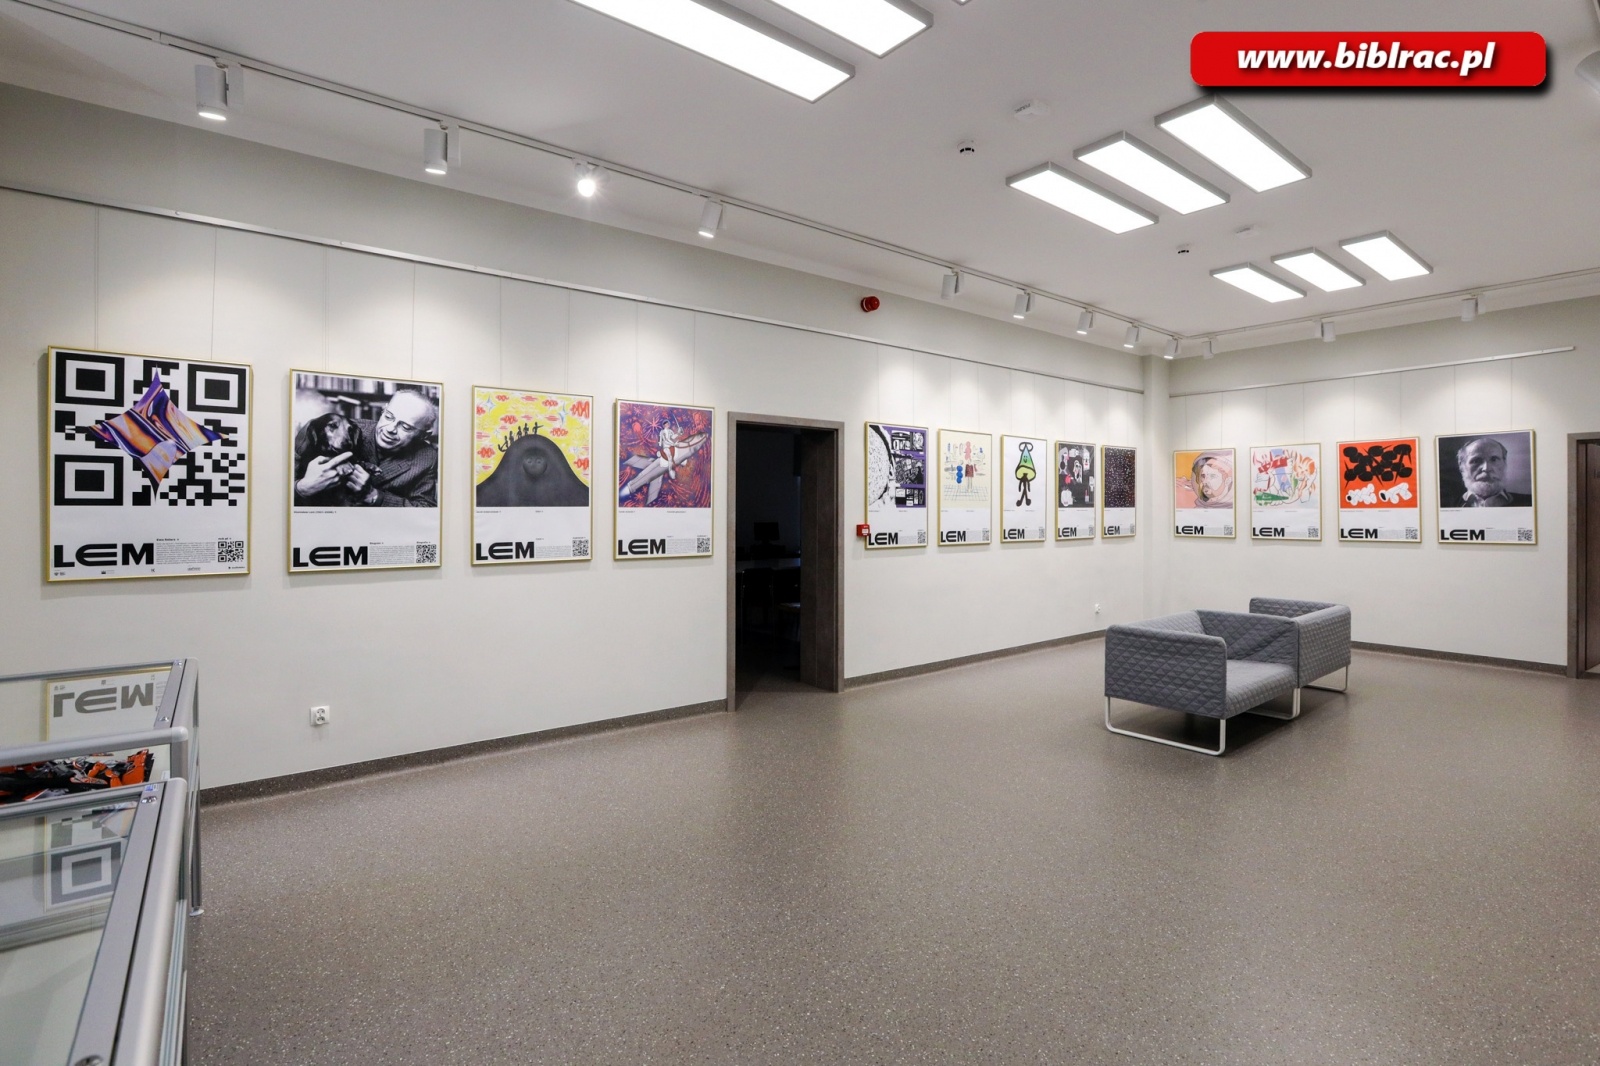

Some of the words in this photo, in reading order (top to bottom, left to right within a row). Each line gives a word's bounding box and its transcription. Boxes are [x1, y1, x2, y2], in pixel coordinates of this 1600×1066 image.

[1003, 528, 1025, 540] LEM
[1057, 527, 1077, 537] LEM
[1103, 525, 1120, 536] LEM
[1175, 525, 1204, 535] LEM
[1252, 526, 1285, 538] LEM
[1340, 528, 1378, 540] LEM
[1440, 529, 1485, 541] LEM
[868, 532, 898, 546] LEM
[940, 532, 966, 543] LEM
[476, 541, 535, 560] LEM
[618, 539, 666, 555] LEM
[54, 543, 154, 567] LEM
[293, 546, 368, 567] LEM
